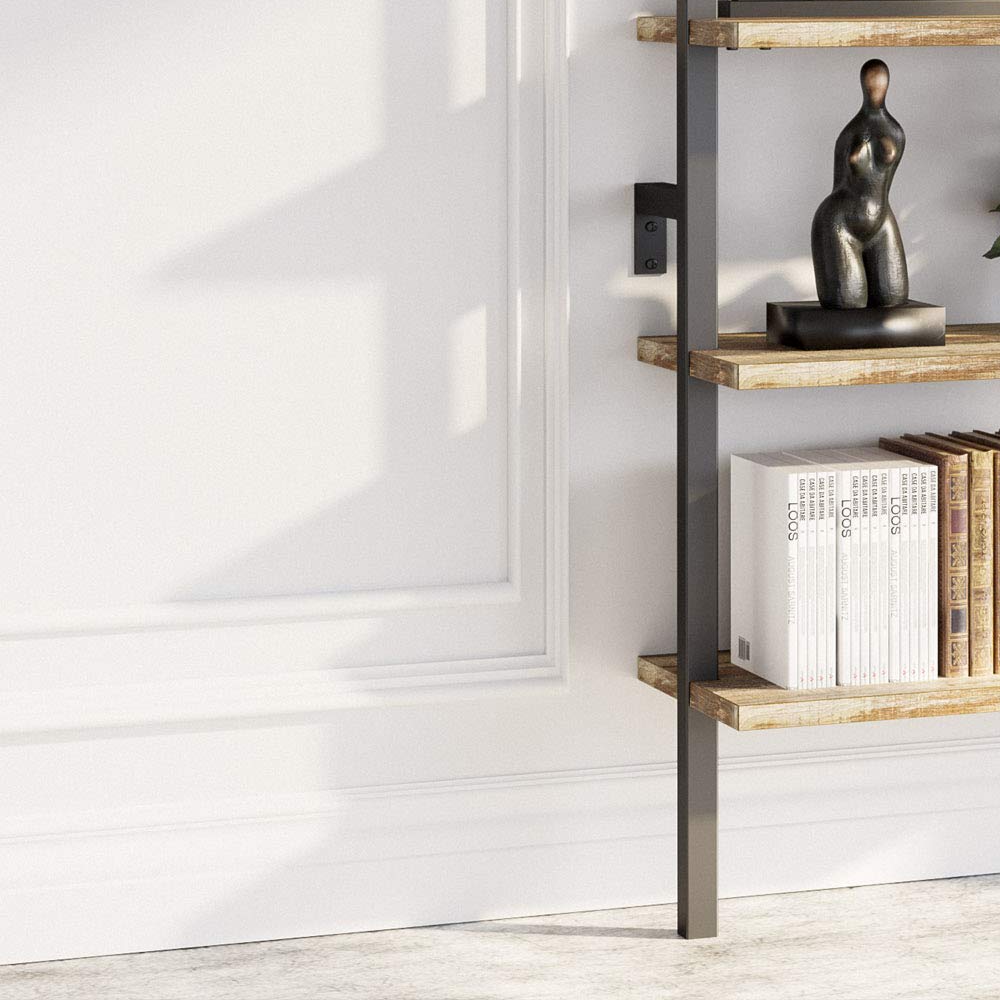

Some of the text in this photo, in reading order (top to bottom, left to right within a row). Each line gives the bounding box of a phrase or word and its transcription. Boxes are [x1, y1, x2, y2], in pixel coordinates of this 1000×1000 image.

[881, 486, 887, 494] DA
[902, 487, 908, 495] DA
[911, 486, 917, 494] DA
[930, 483, 936, 491] DA
[828, 489, 834, 497] DA
[852, 489, 859, 497] DA
[872, 488, 878, 496] DA
[841, 499, 852, 538] LOOS
[890, 497, 901, 535] LOOS
[788, 502, 798, 541] LOOS
